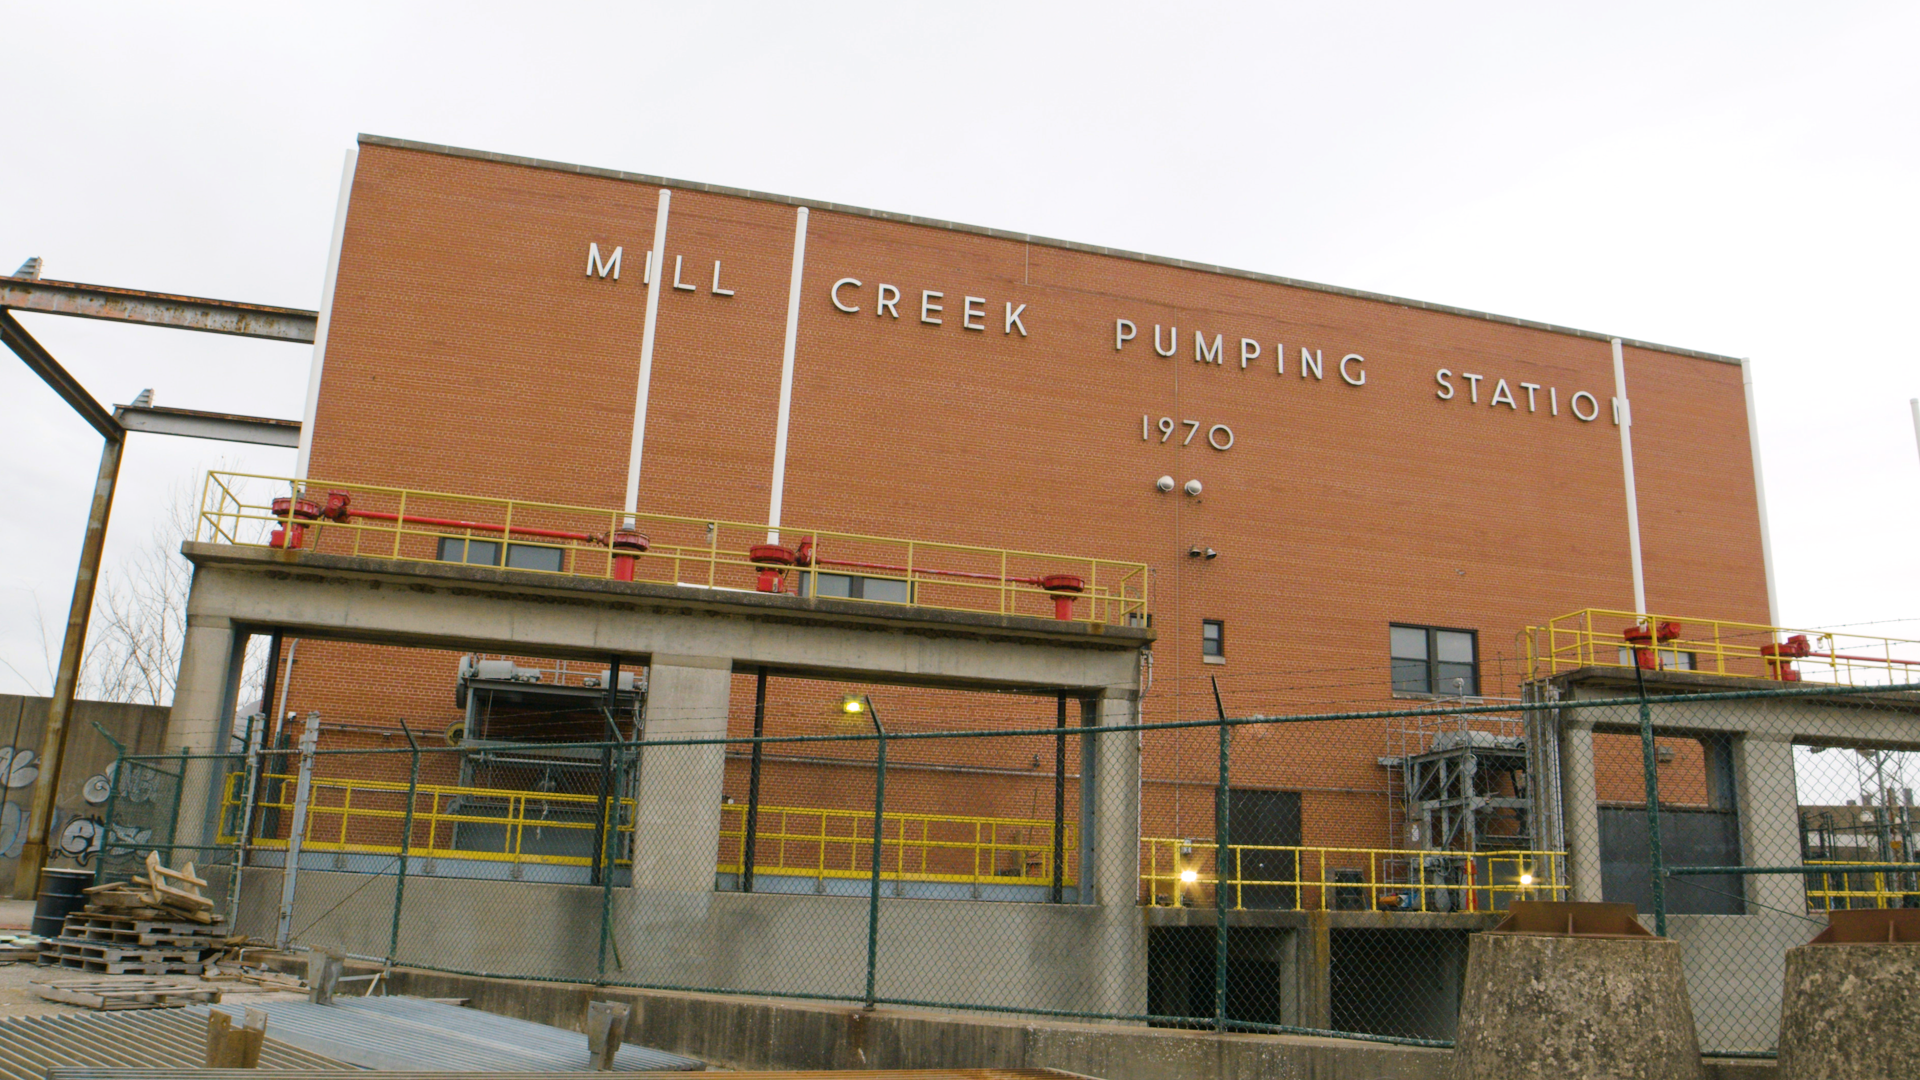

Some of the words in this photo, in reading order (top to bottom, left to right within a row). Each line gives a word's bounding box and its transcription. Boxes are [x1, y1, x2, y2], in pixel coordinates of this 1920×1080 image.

[585, 242, 735, 296] MILL
[830, 277, 1028, 337] CREEK
[1114, 318, 1366, 387] PUMPING
[1141, 413, 1235, 451] 1970
